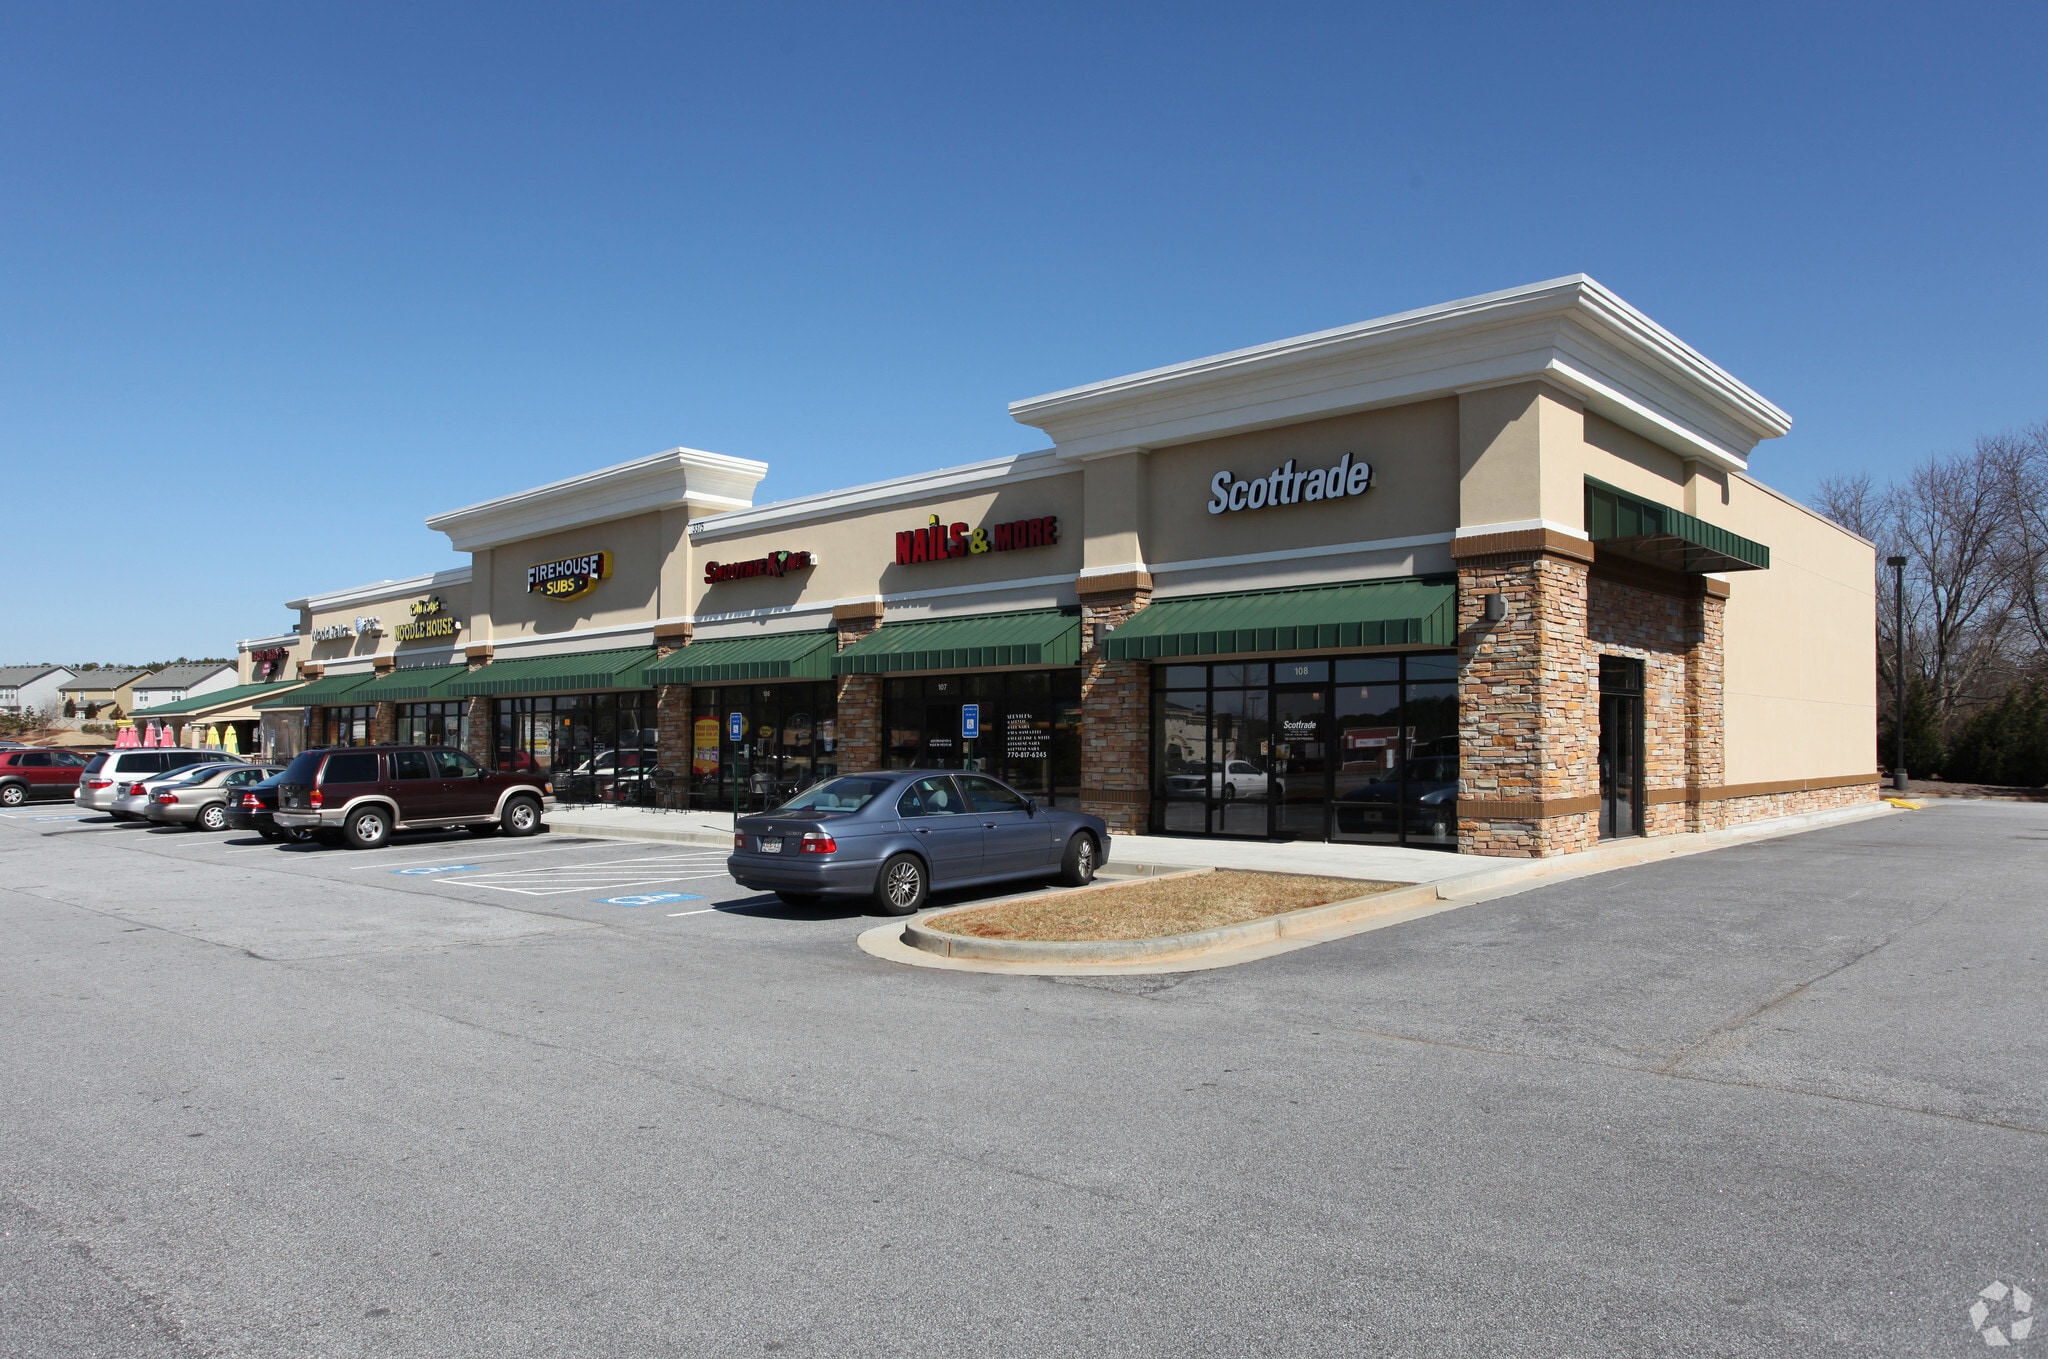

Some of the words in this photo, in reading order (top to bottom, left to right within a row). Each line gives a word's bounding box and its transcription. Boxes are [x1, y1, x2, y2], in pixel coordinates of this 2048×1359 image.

[1207, 452, 1372, 515] Scottrade
[896, 514, 969, 565] NAILS
[970, 528, 991, 554] &
[994, 516, 1057, 552] MORE
[527, 555, 599, 592] FIREHOUSE
[546, 578, 575, 595] SUBS
[394, 622, 425, 641] NOODLE
[426, 617, 454, 637] HOUSE
[1294, 667, 1309, 675] 108
[1283, 720, 1317, 729] Scottrade
